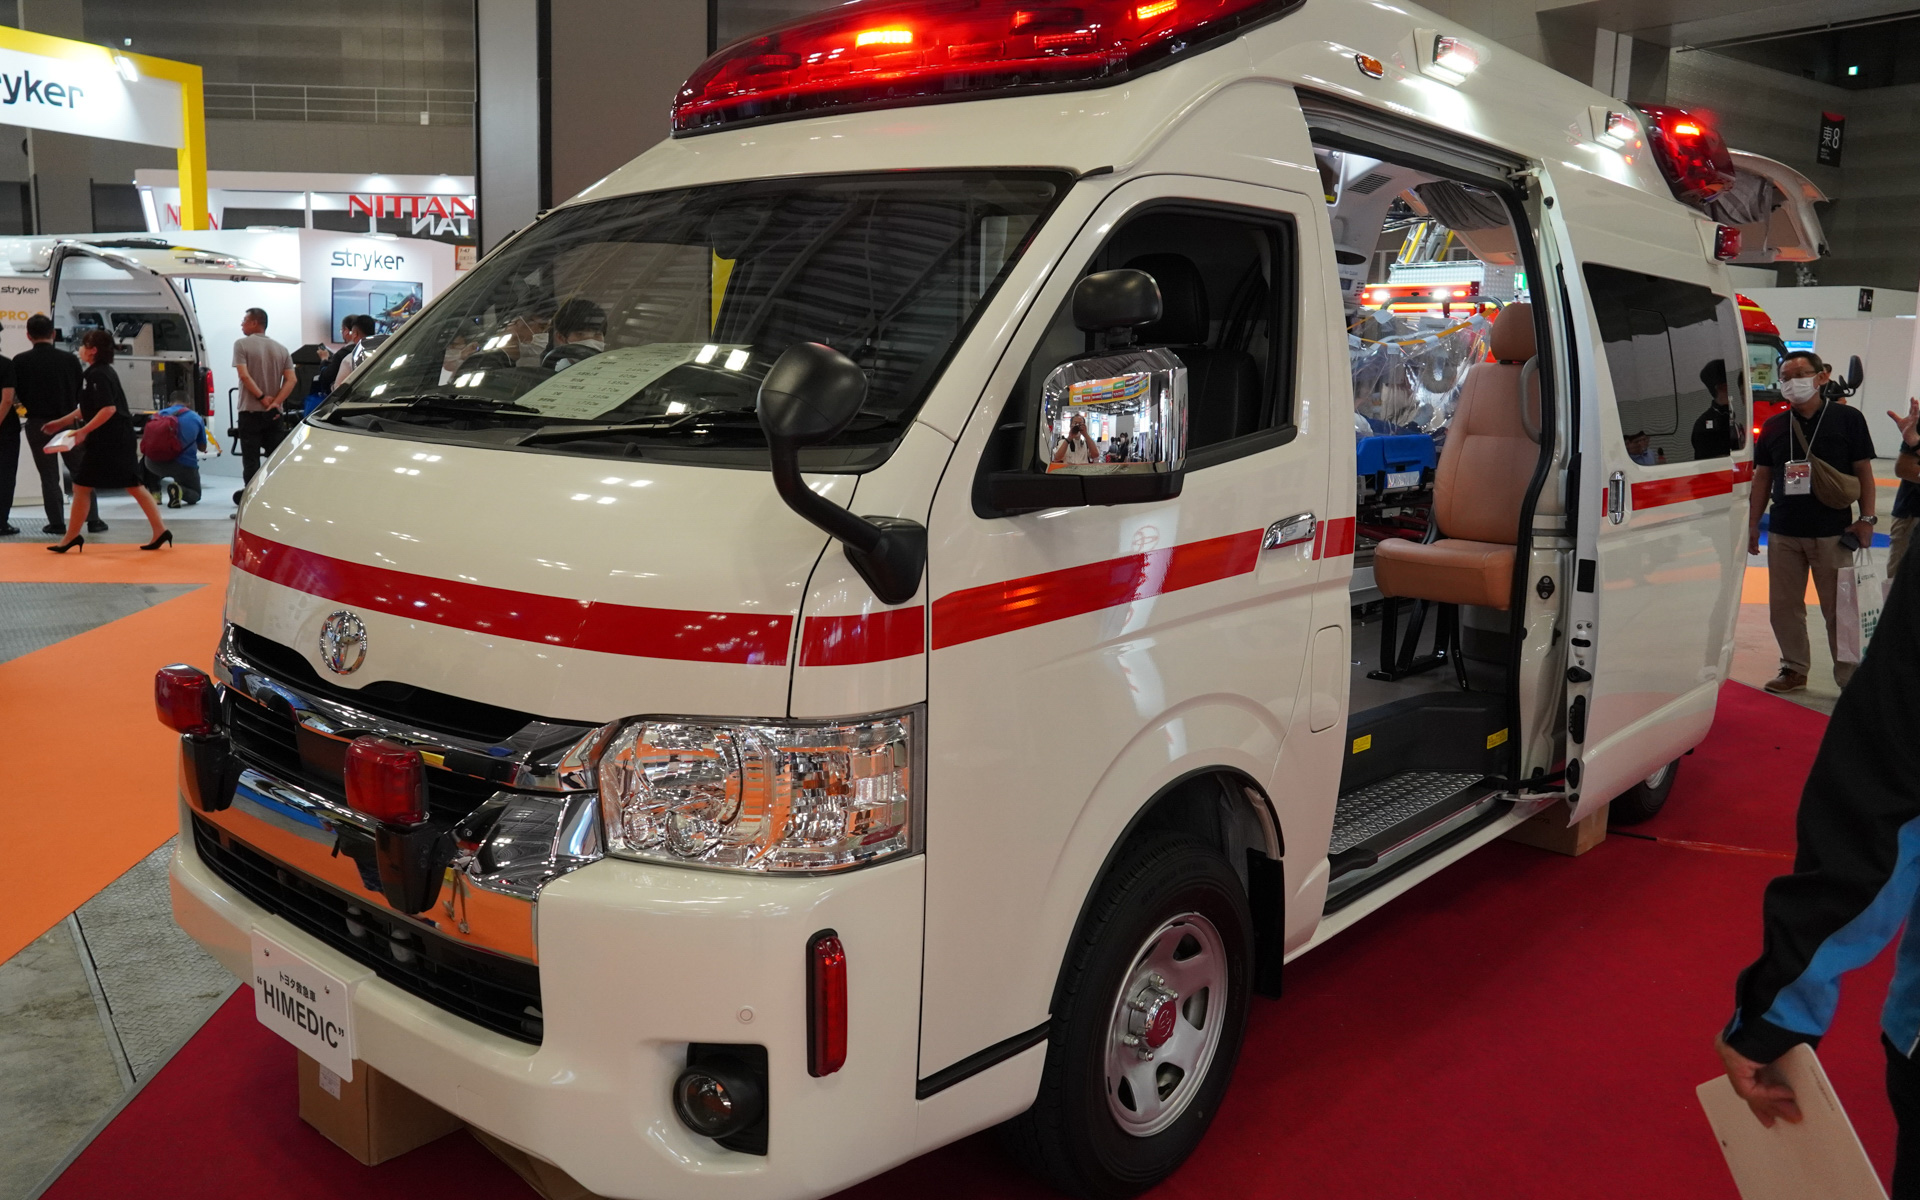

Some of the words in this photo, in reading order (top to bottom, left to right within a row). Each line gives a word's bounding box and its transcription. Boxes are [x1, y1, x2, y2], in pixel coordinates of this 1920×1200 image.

[0, 70, 84, 109] yker
[348, 195, 476, 219] NITTAN
[331, 248, 405, 272] stryker
[1, 285, 40, 295] stryker
[0, 310, 28, 321] PRO
[279, 971, 316, 1002] トヨタ救急車
